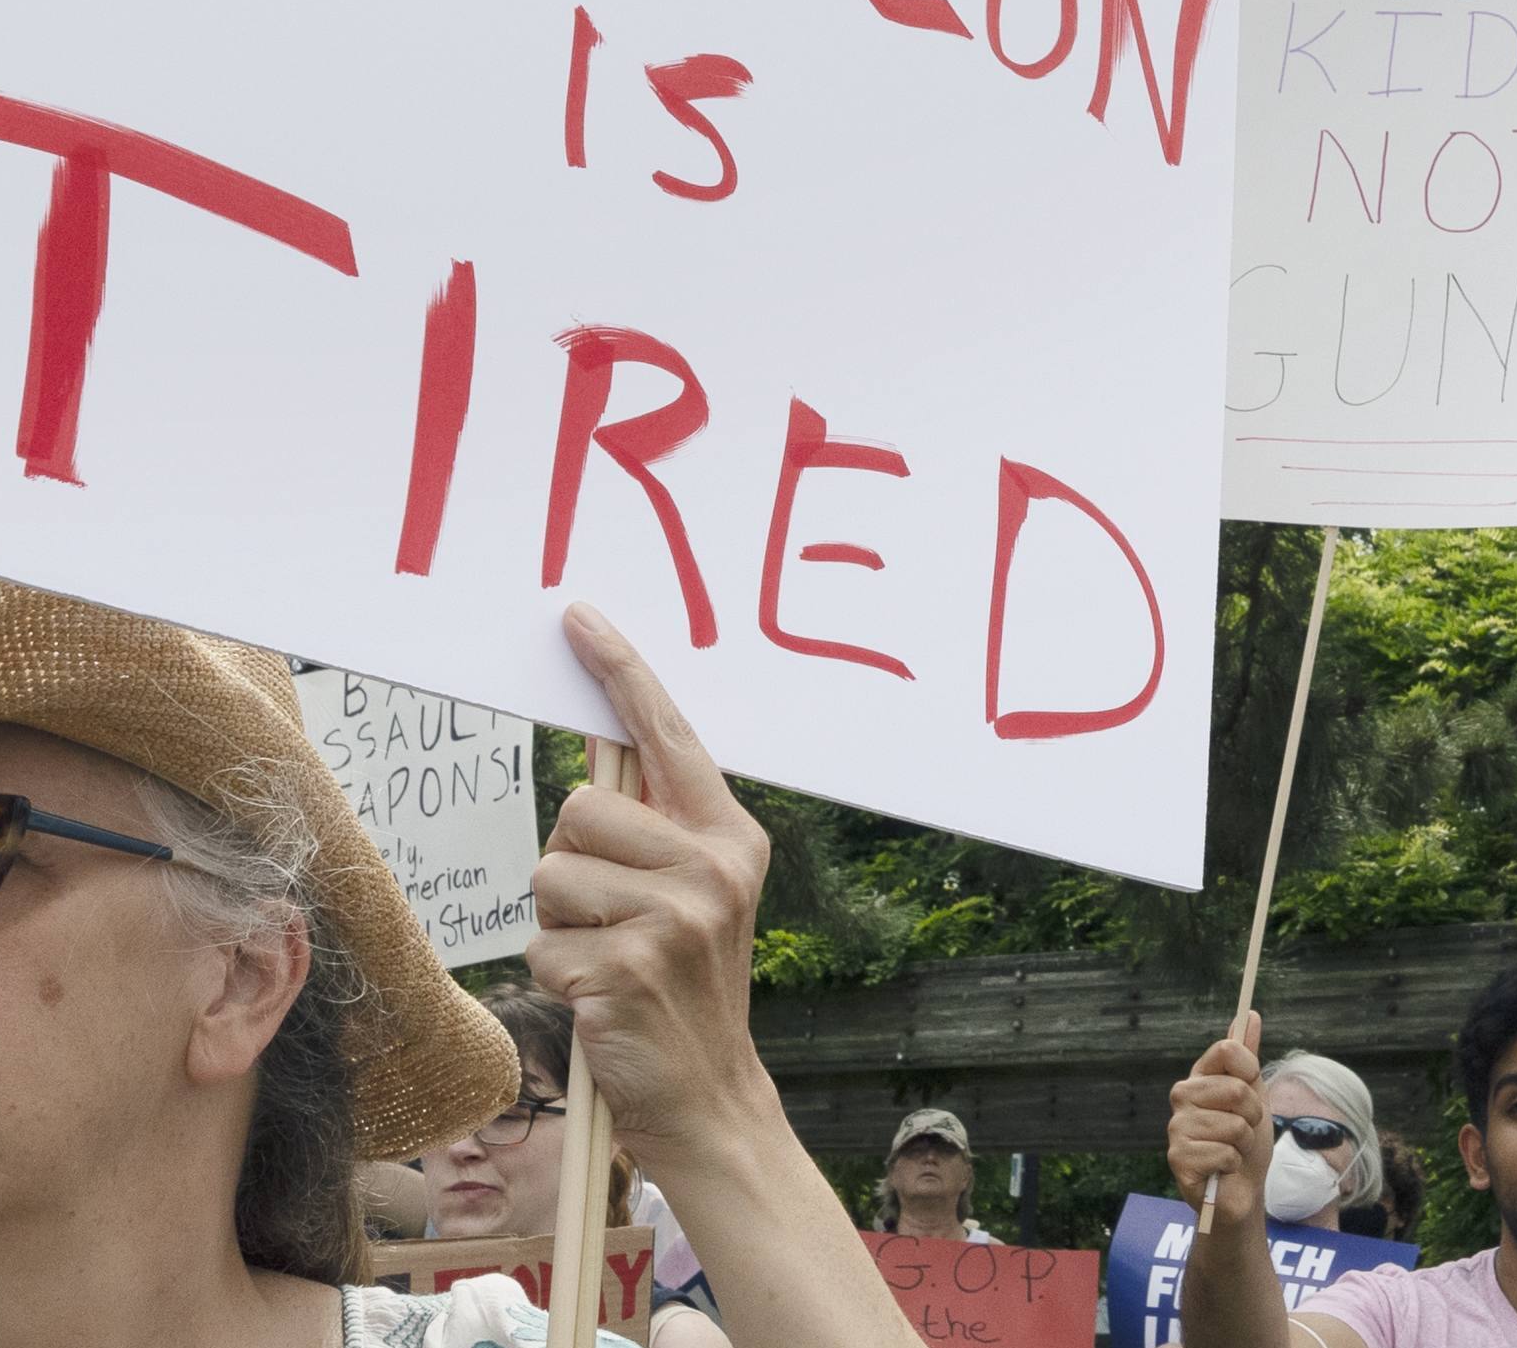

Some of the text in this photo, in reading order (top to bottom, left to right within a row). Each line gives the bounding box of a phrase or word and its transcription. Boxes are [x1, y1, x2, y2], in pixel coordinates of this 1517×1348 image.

[565, 4, 754, 203] IS
[323, 700, 497, 772] SSAUL
[393, 866, 488, 903] merican
[439, 882, 534, 948] Student
[1153, 1221, 1337, 1282] MCH
[920, 1303, 1001, 1345] the
